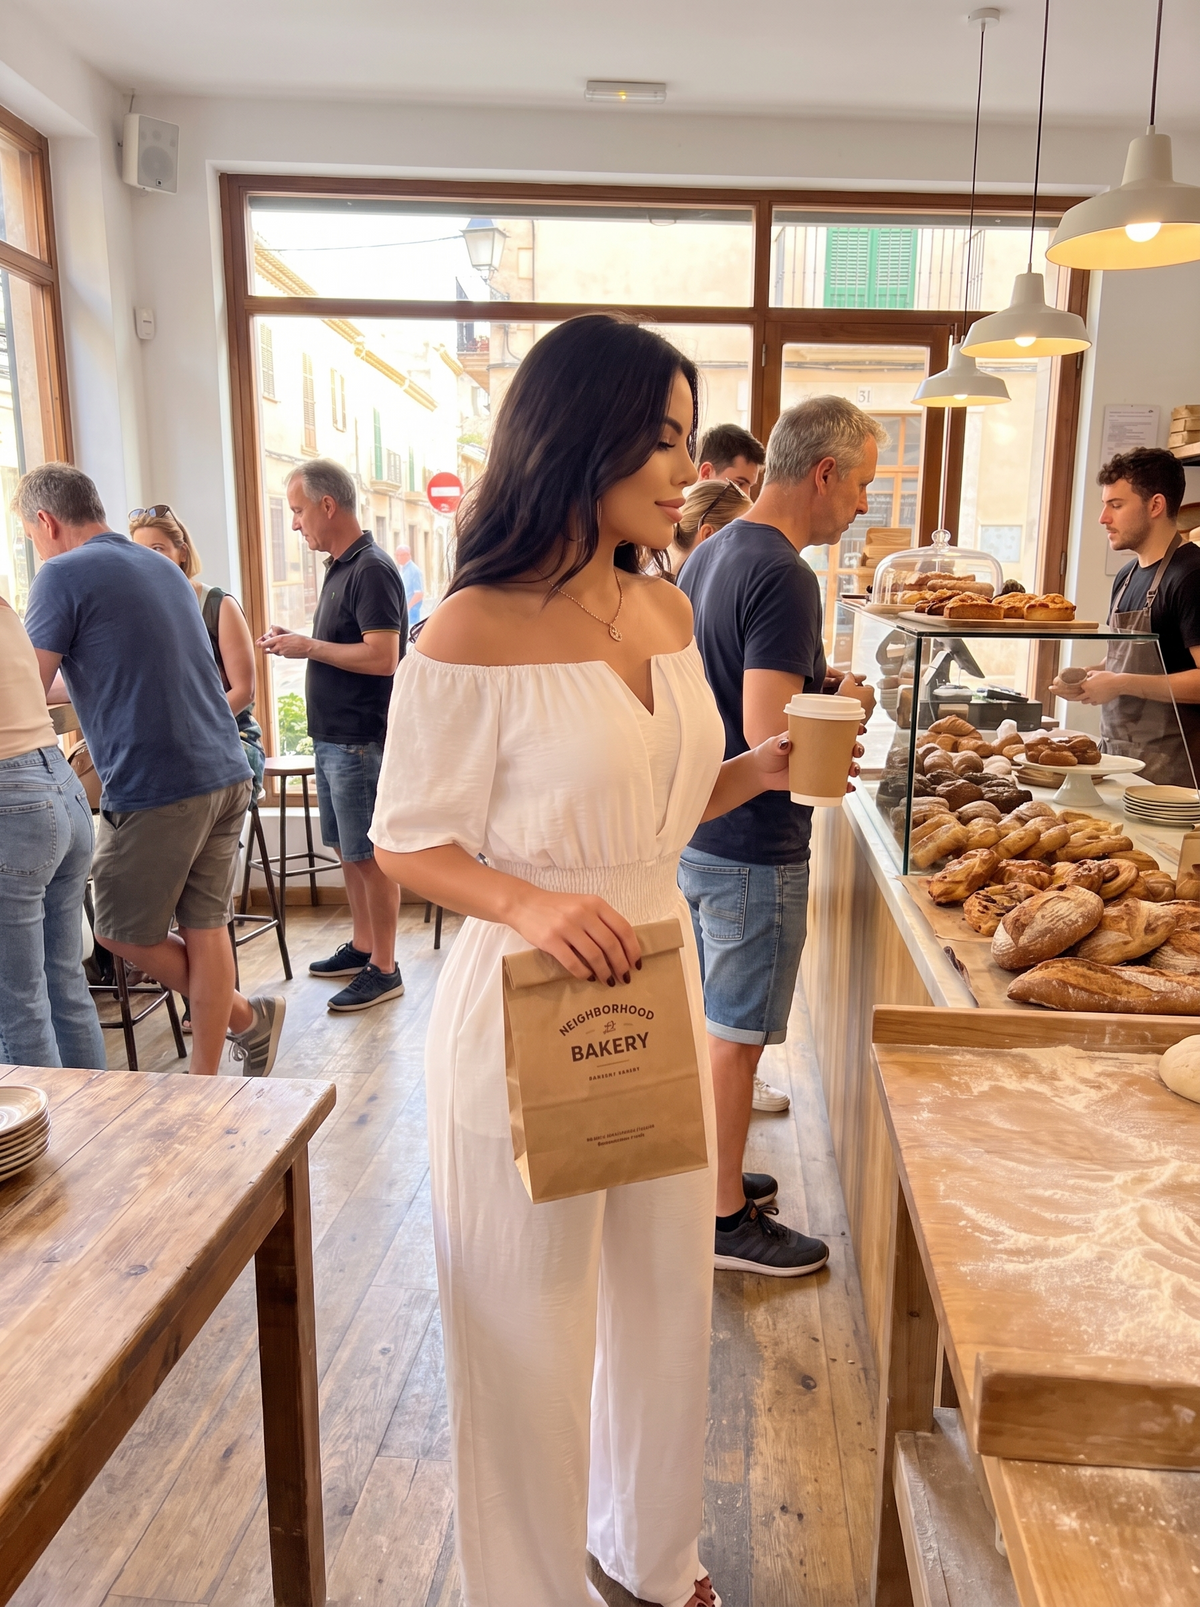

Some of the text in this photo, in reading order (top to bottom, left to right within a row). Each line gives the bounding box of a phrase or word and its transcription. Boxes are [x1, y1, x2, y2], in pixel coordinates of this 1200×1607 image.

[859, 391, 871, 403] 31
[559, 1003, 655, 1036] NEIGHBORHOOD
[571, 1031, 649, 1062] BAKERY
